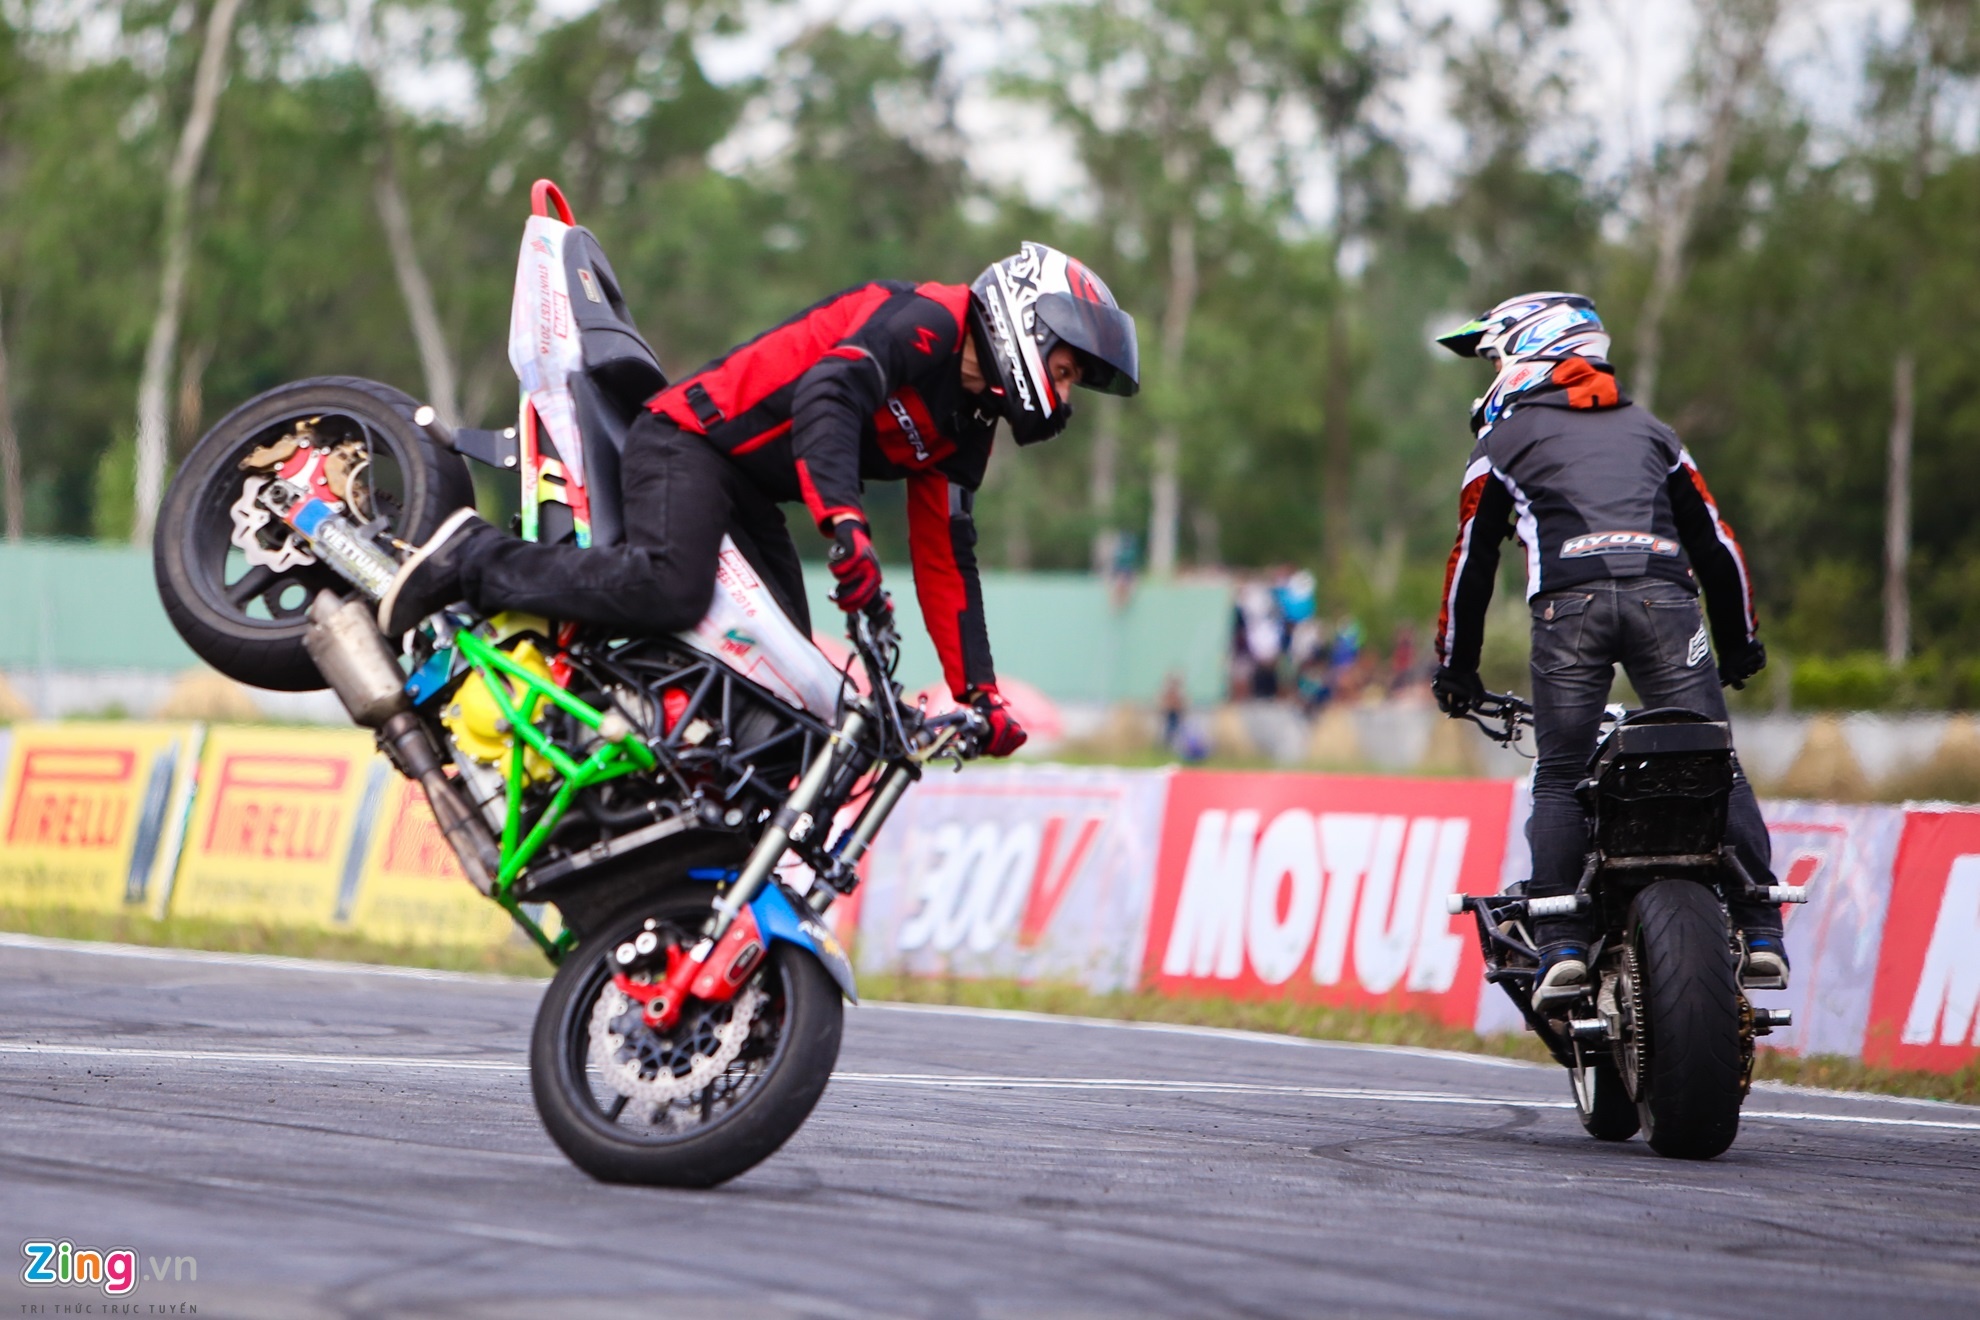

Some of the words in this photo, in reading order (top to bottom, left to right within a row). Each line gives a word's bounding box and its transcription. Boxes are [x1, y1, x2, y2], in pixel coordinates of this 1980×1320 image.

[985, 284, 1035, 412] SCORPION
[1563, 533, 1655, 553] HYOD
[731, 590, 757, 618] 2016
[6, 747, 136, 847] PIRELLI
[204, 755, 351, 862] PIRELLI
[899, 816, 1104, 951] 300V
[1162, 807, 1470, 995] MOTUL
